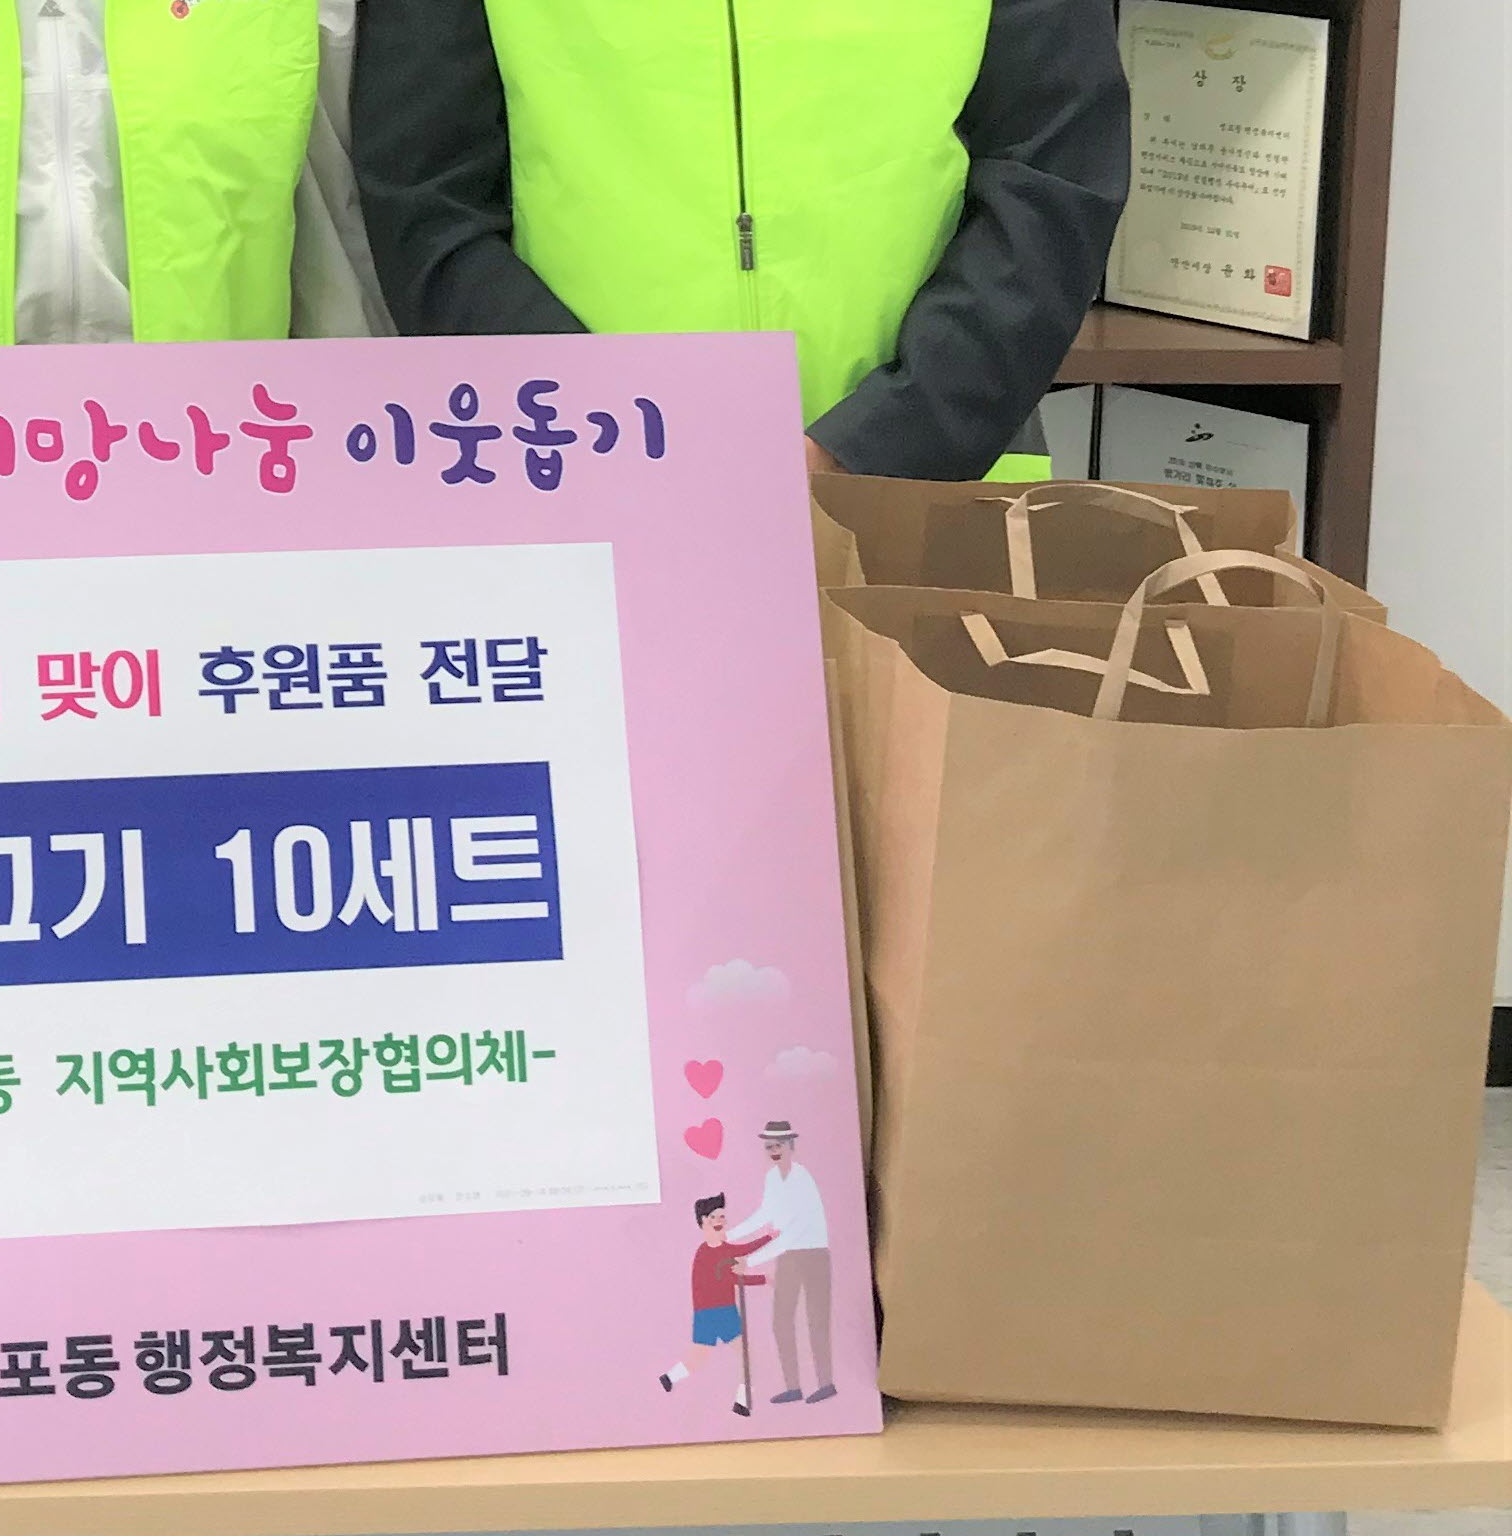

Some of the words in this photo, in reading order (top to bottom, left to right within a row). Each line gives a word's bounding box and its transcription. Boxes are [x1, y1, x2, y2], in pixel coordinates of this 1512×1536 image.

[347, 379, 666, 492] 이웃돕기
[37, 649, 162, 721] 맞이
[198, 642, 388, 715] 후원품
[419, 636, 549, 705] 전달
[216, 814, 550, 936] 10세트
[56, 1029, 556, 1107] 지역사회보장협의체-
[135, 1312, 509, 1395] 행정복지센터
